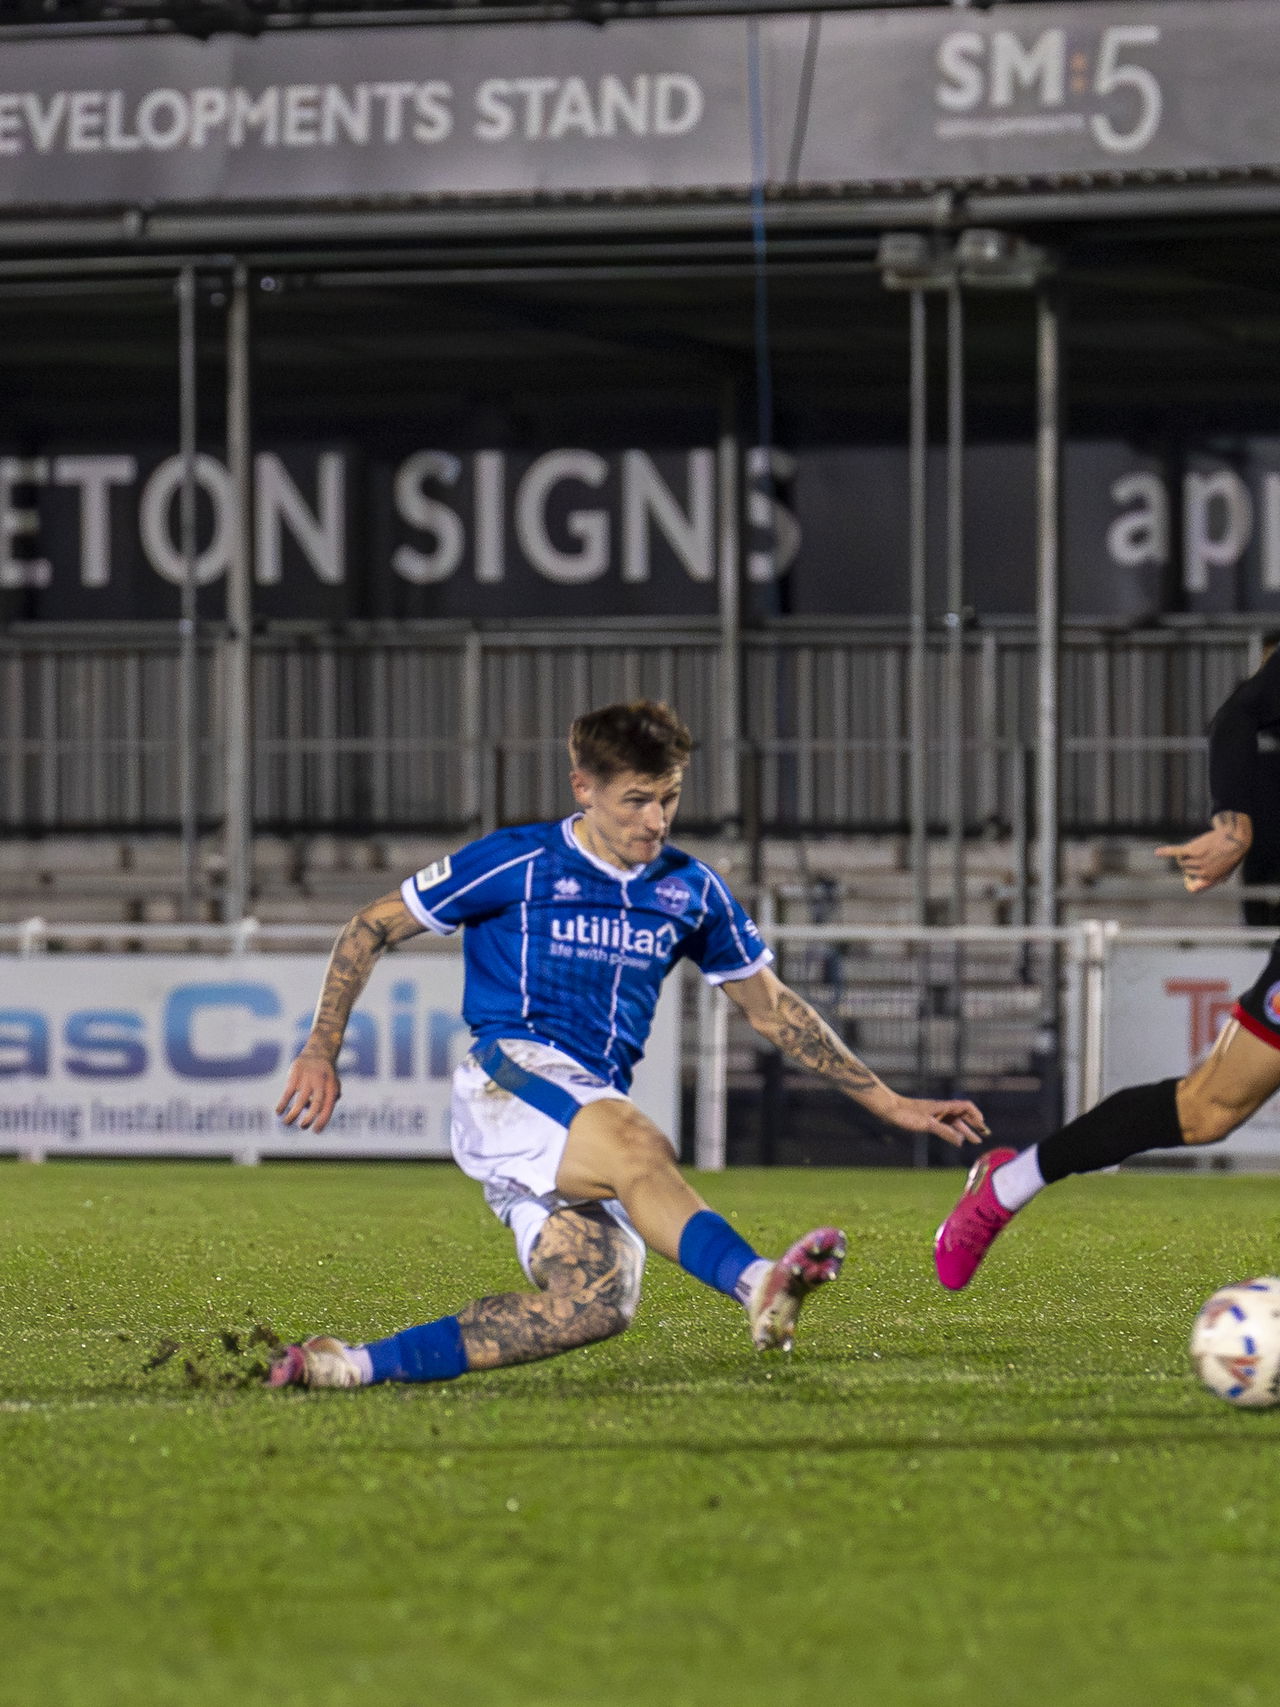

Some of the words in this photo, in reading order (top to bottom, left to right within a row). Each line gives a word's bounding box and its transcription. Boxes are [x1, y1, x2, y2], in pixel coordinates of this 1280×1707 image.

[0, 80, 454, 153] EVELOPMENTS
[472, 72, 705, 140] STAND
[551, 914, 655, 955] utilita
[318, 1098, 428, 1134] ervice
